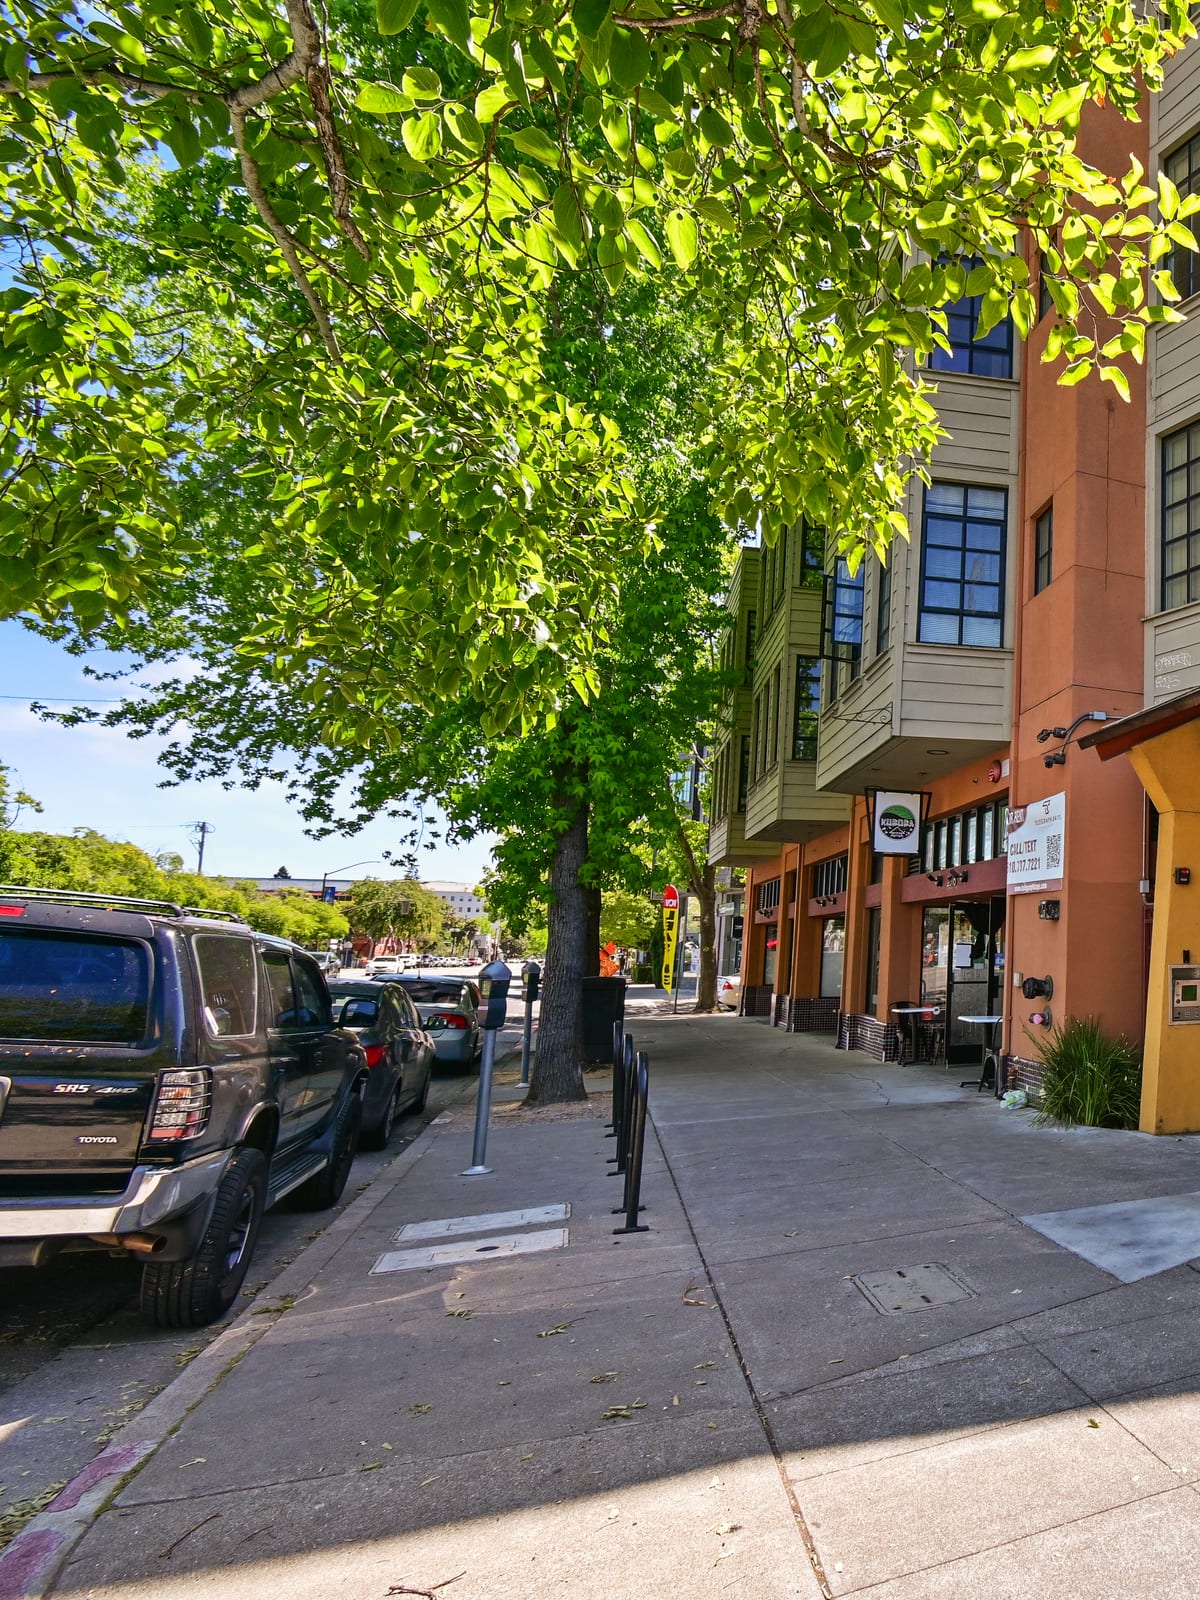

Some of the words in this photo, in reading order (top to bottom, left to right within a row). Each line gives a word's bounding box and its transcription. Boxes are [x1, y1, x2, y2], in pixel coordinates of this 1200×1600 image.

[1008, 857, 1041, 873] 10.737.7221
[53, 1084, 91, 1093] SR5
[96, 1086, 138, 1094] 4WD
[78, 1136, 118, 1144] TOYOTA
